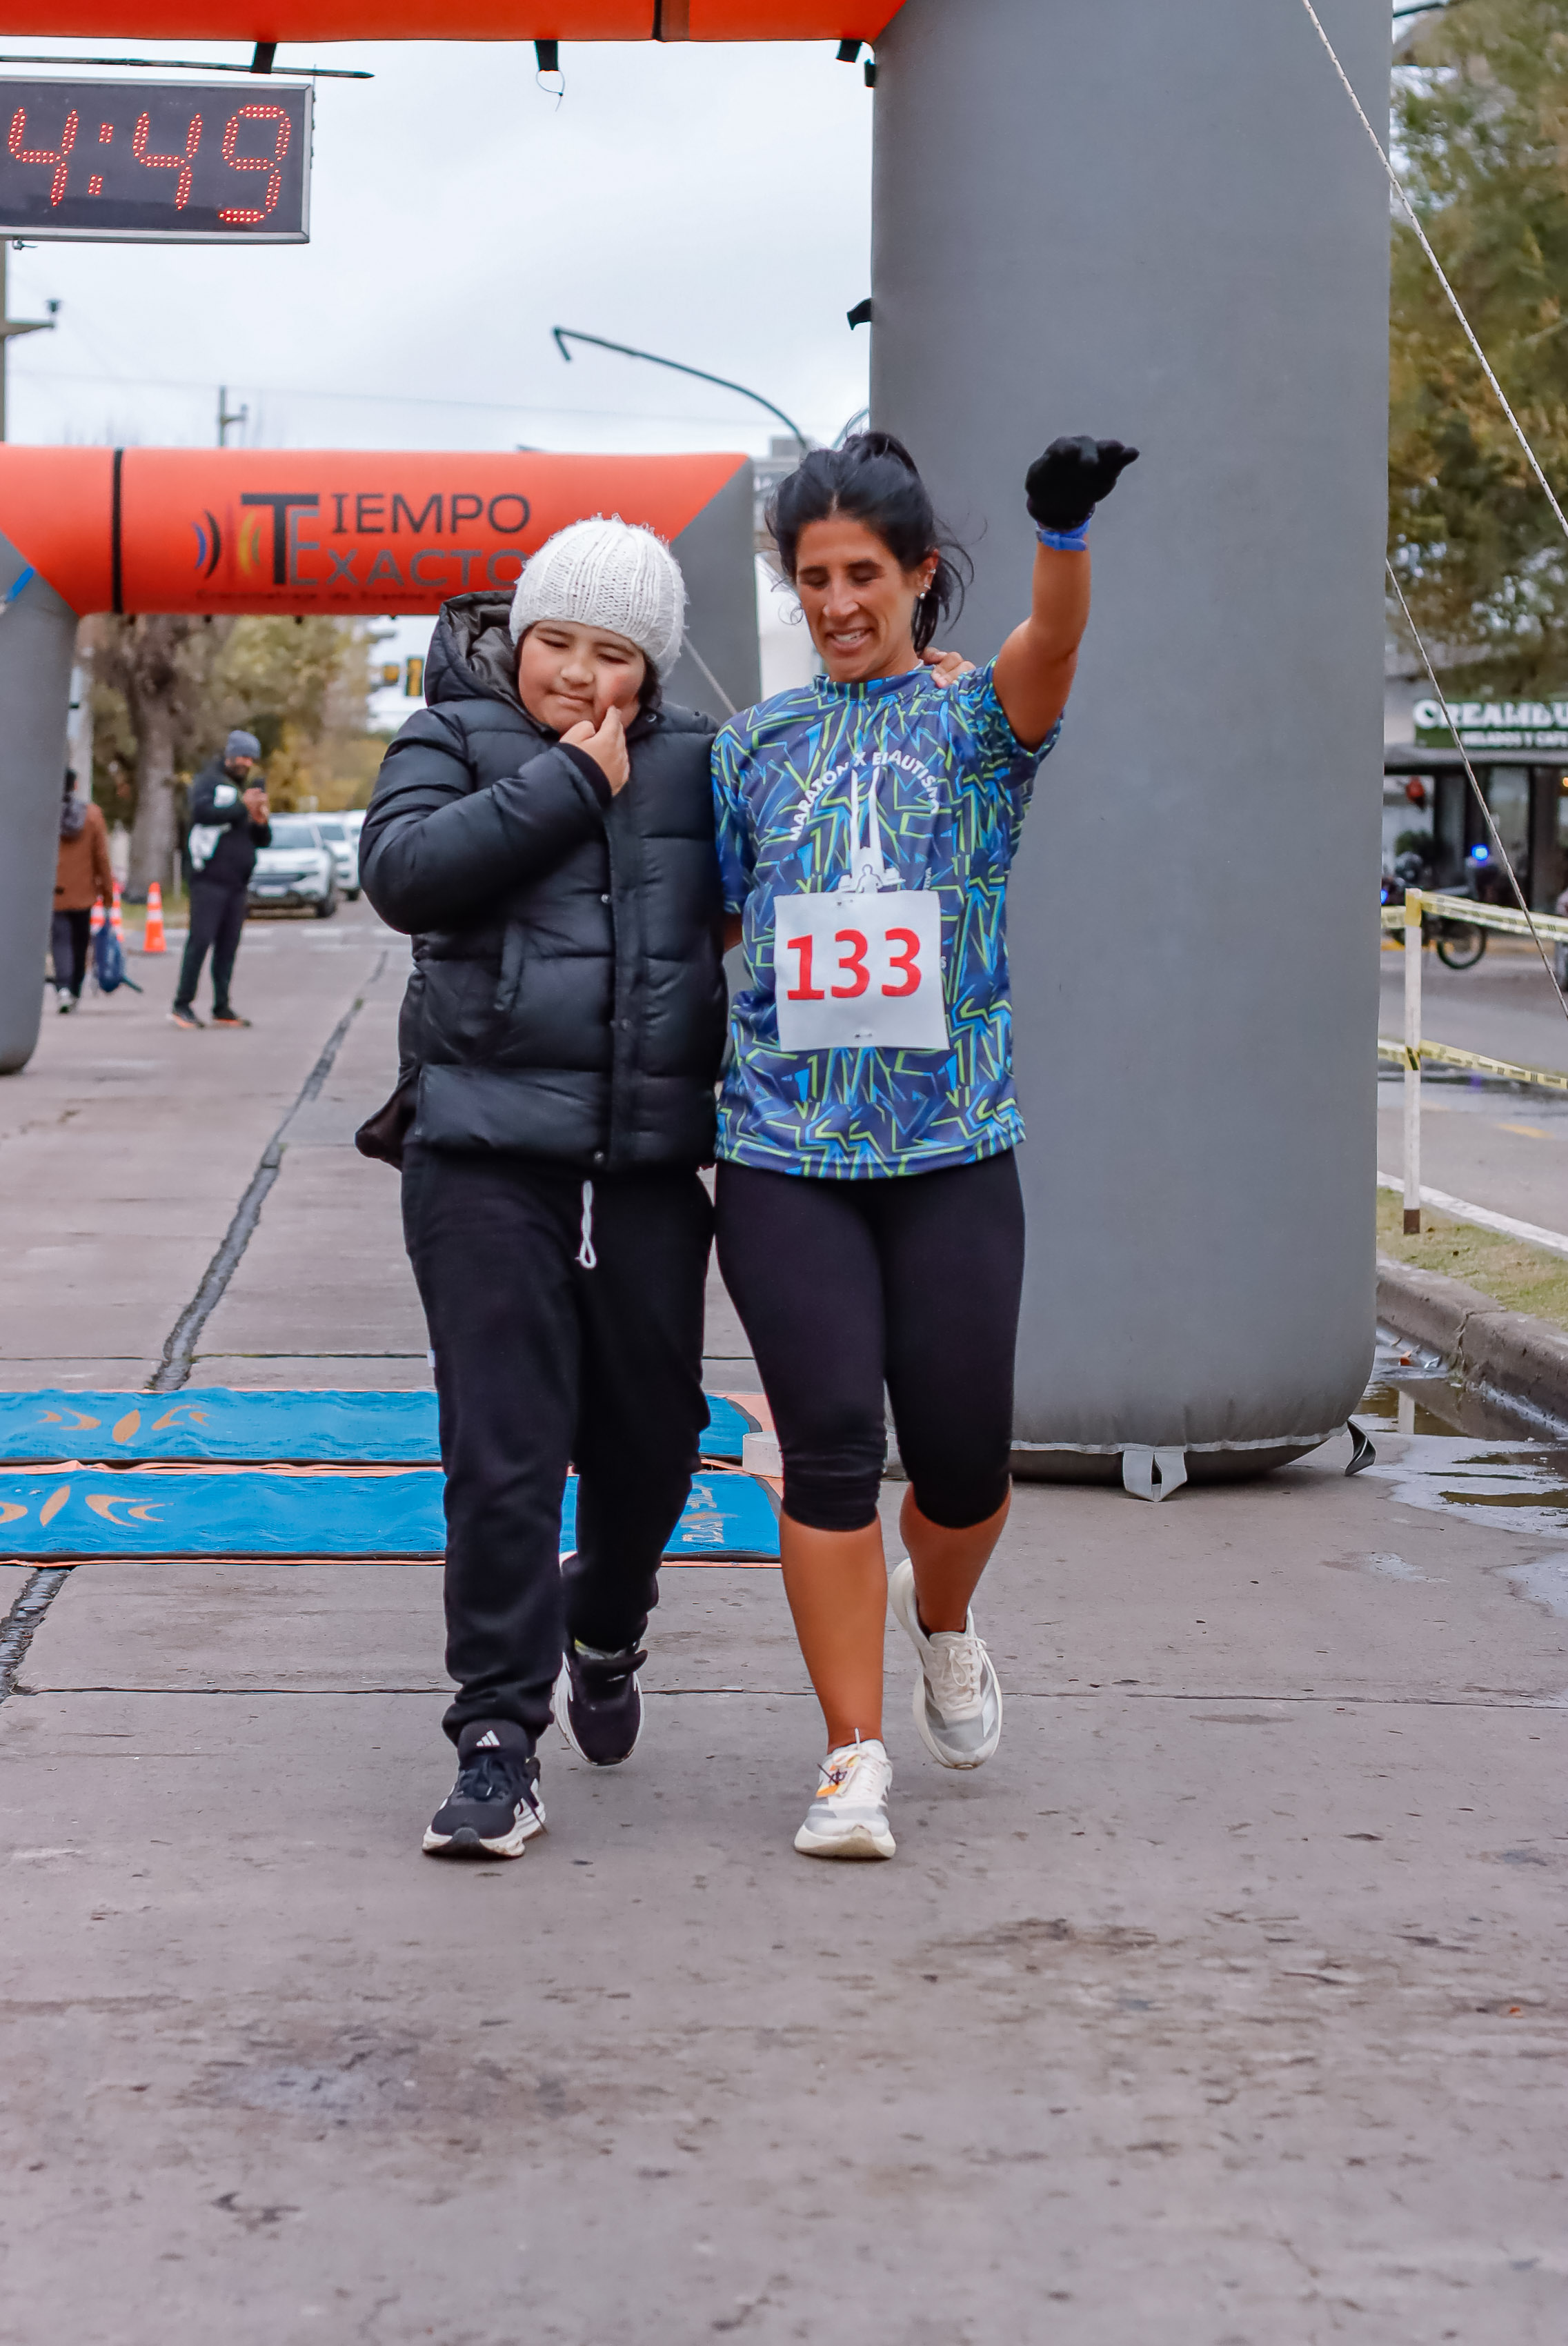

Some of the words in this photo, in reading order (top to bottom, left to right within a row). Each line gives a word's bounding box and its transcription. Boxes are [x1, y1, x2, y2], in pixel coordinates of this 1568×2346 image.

[8, 105, 292, 223] 4:49
[241, 493, 530, 586] TIEMPO
[290, 509, 526, 586] EXACTO
[853, 750, 867, 767] X
[786, 926, 922, 1000] 133
